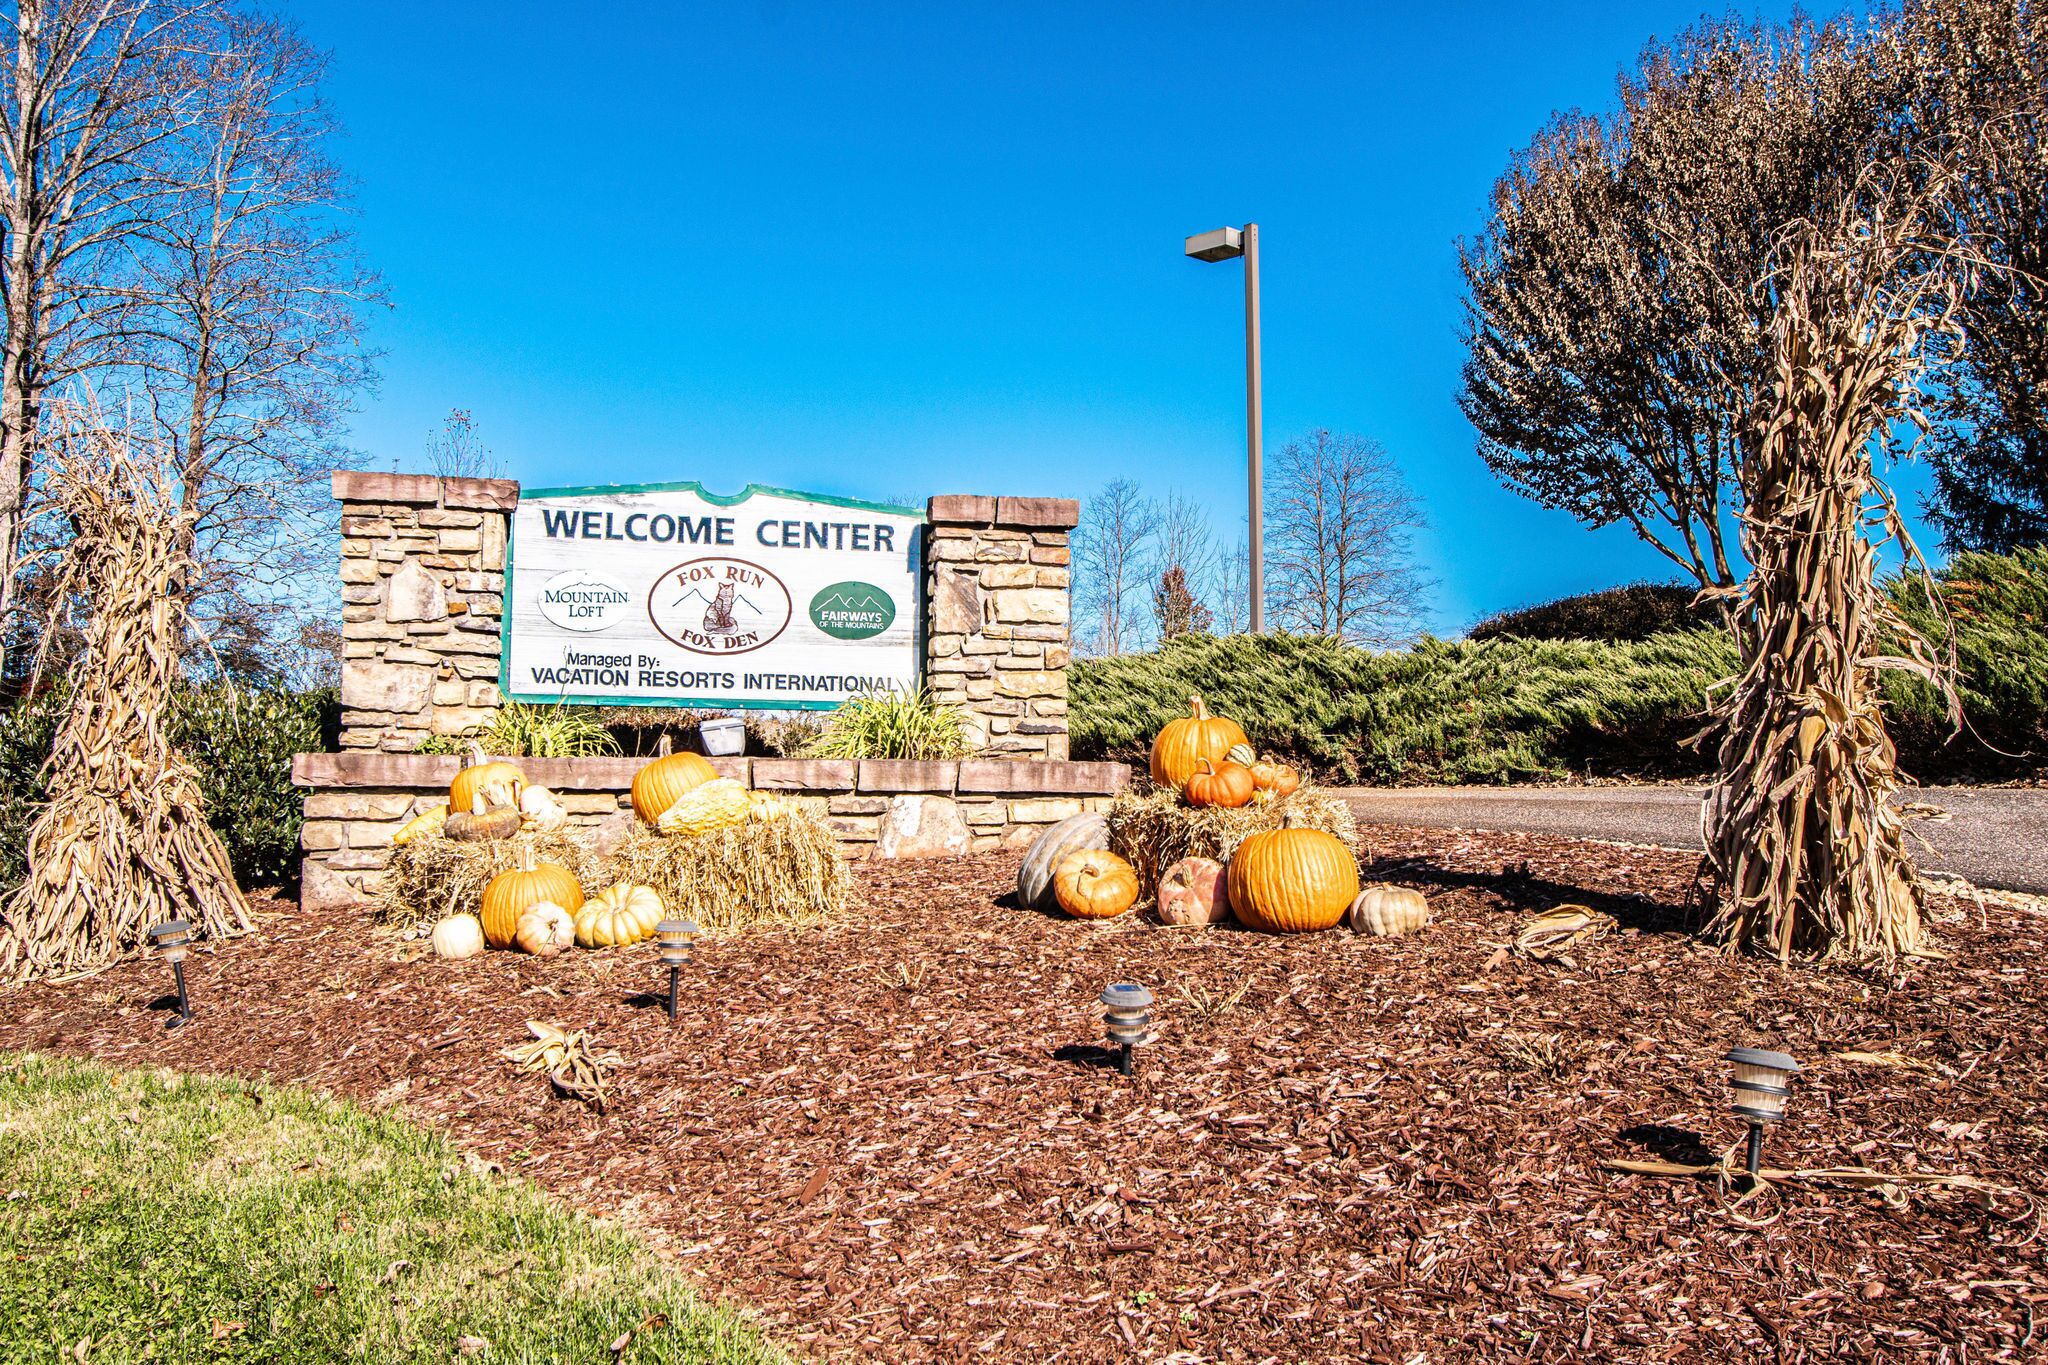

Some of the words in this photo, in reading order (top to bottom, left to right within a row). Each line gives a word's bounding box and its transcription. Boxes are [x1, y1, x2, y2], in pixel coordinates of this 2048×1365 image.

[543, 509, 735, 546] WELCOME
[756, 519, 895, 552] CENTER
[677, 566, 715, 587] FOX
[726, 566, 765, 588] RUN
[545, 590, 629, 603] MOUNTAIN
[568, 604, 605, 617] LOFT
[821, 611, 882, 622] FAIRWAYS
[681, 629, 716, 649] FOX
[724, 631, 759, 649] DEN
[567, 652, 631, 667] Managed
[638, 655, 661, 670] By:
[531, 667, 629, 686] VACATION
[638, 671, 735, 689] RESORTS
[744, 673, 898, 692] INTERNATIONAL
